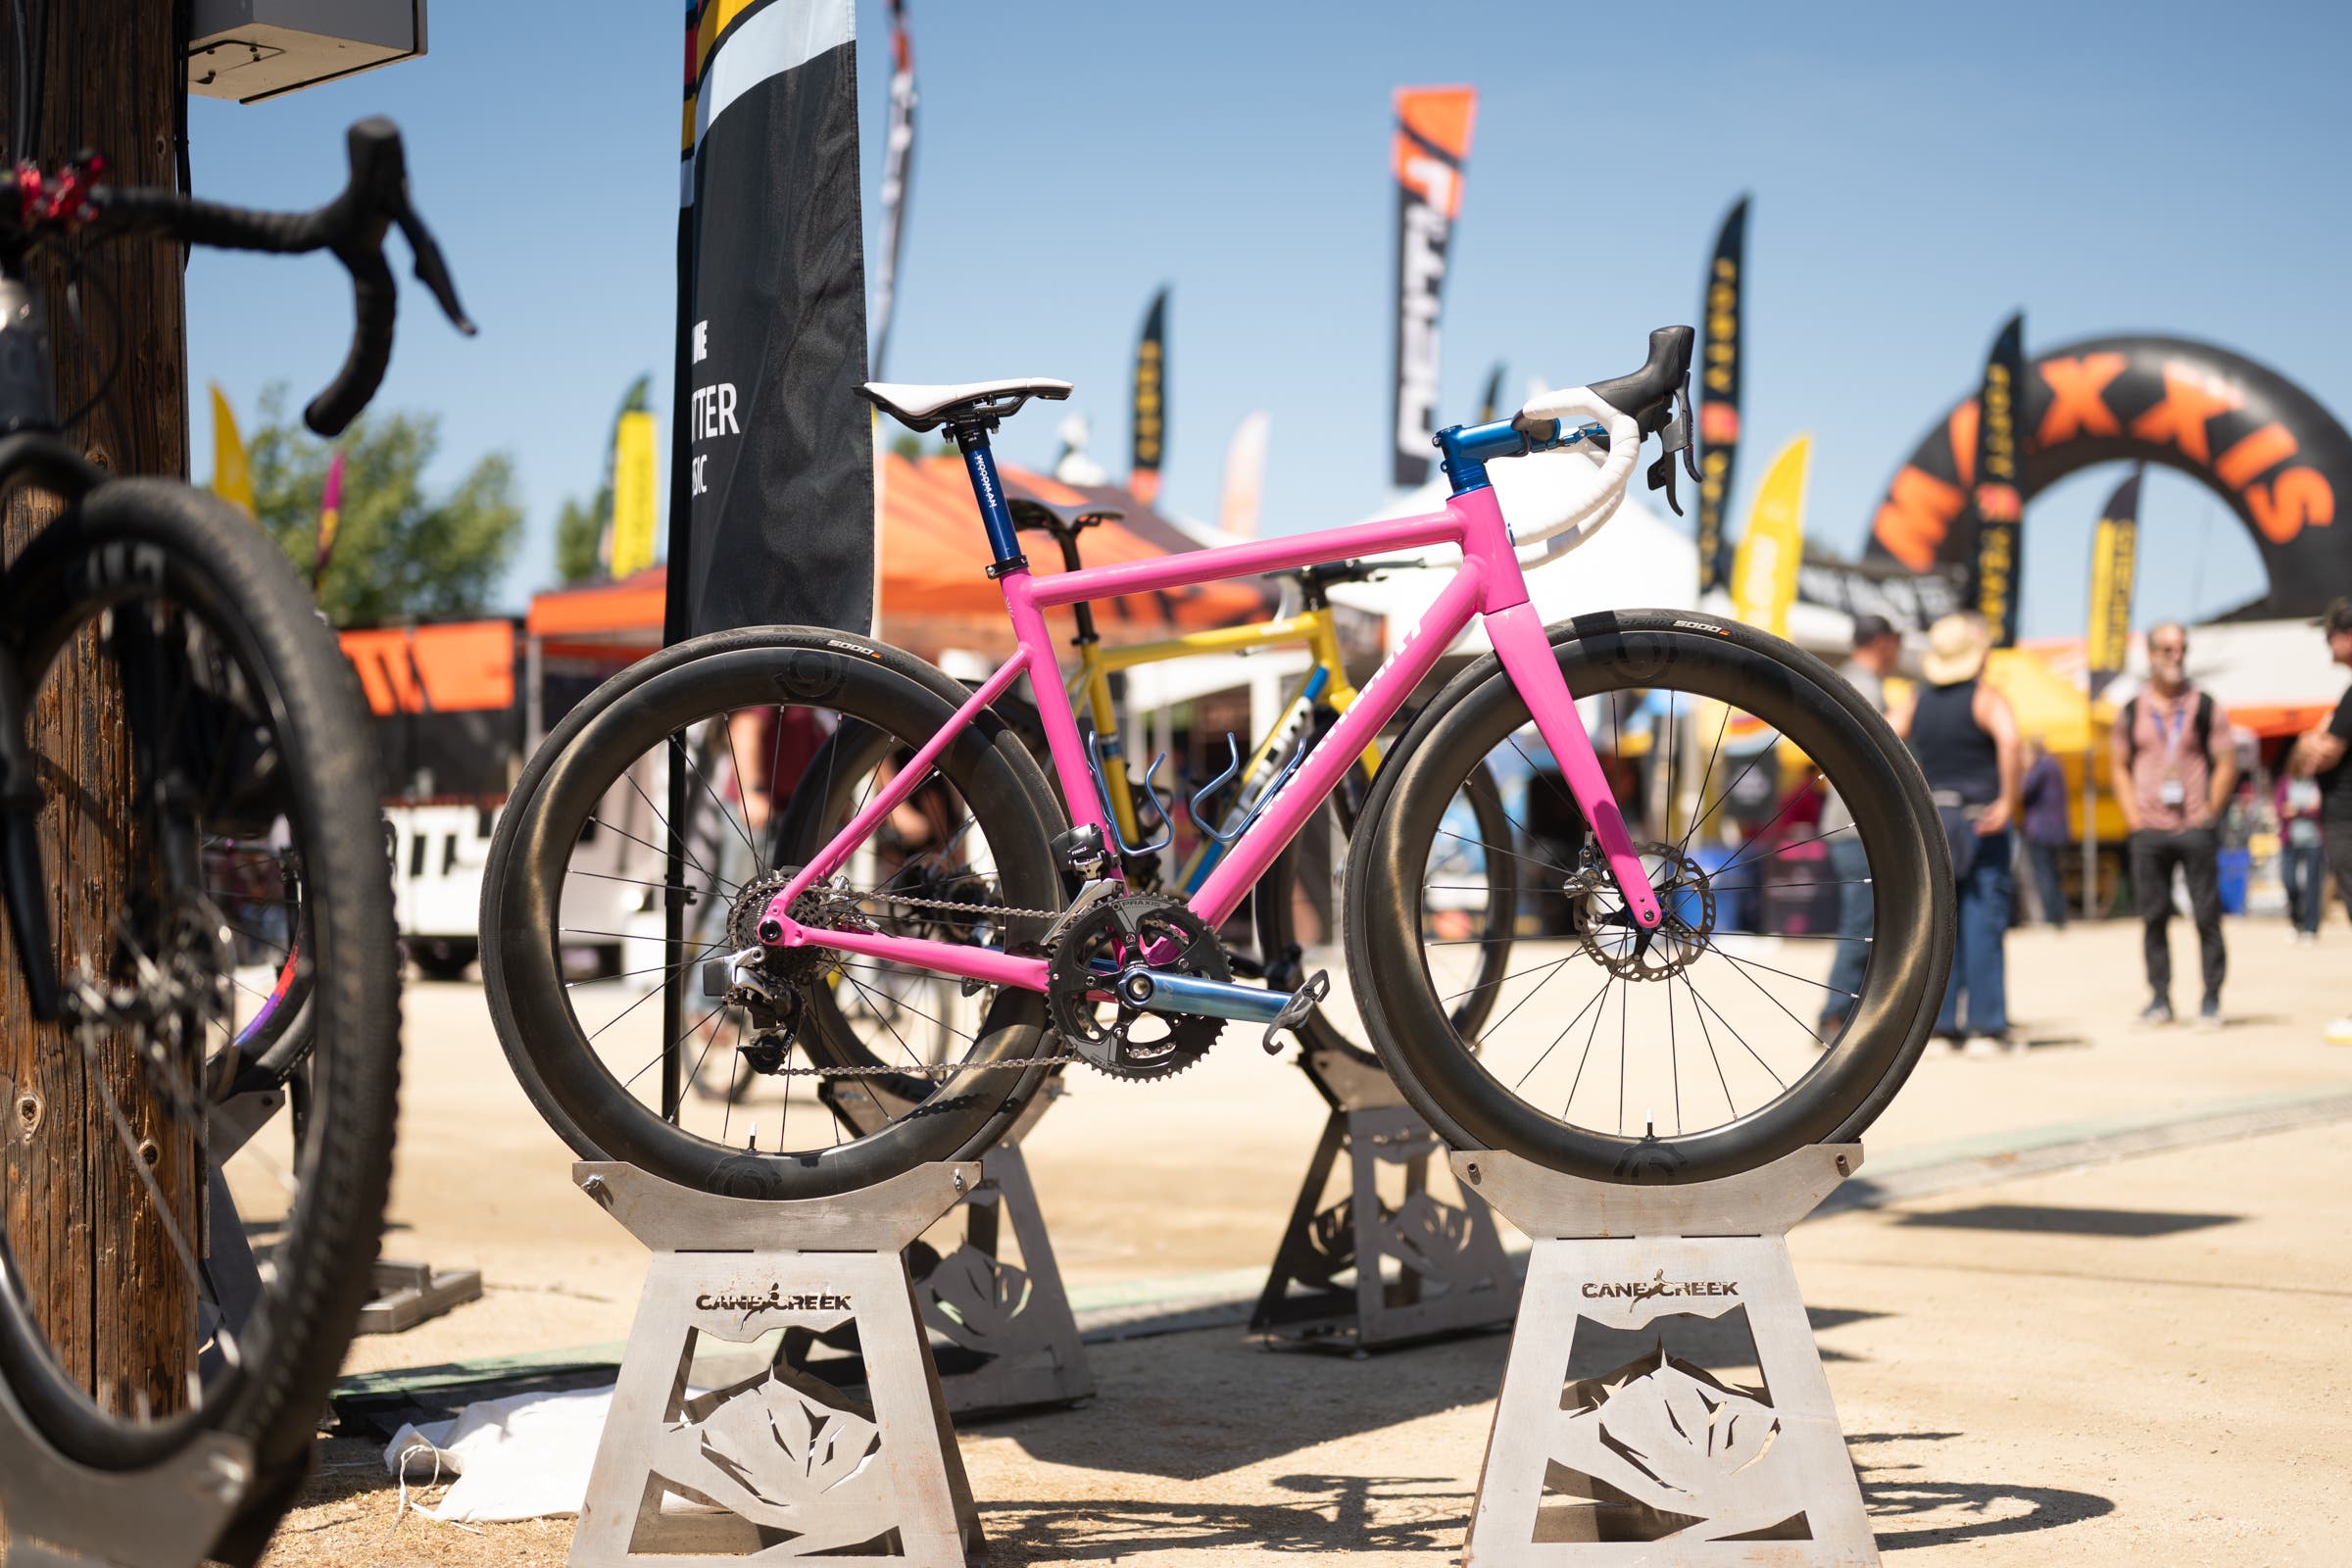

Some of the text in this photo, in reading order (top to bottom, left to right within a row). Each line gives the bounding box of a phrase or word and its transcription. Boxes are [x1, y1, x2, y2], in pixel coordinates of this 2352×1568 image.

[974, 454, 998, 509] WOODMAN
[1673, 619, 1723, 633] 5000
[826, 639, 875, 655] 5000
[1581, 1281, 1740, 1298] CANE CREEK
[771, 1294, 853, 1310] CREEK
